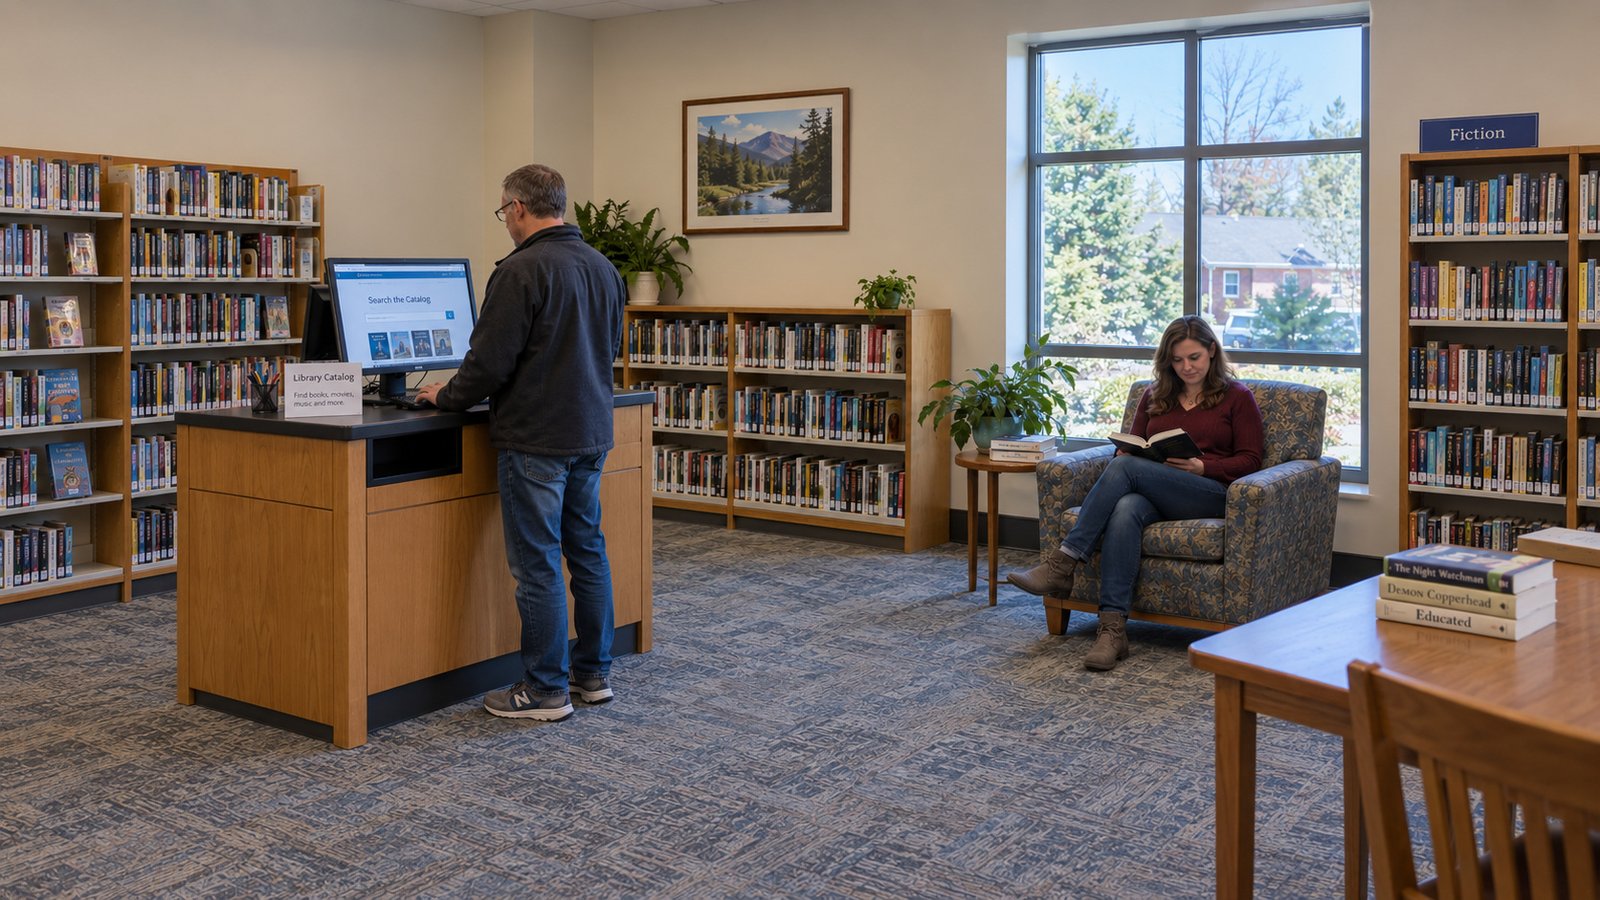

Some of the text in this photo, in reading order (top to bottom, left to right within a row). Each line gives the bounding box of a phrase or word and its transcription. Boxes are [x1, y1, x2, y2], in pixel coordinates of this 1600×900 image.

[1450, 127, 1505, 141] Fiction
[368, 296, 392, 304] Search
[405, 295, 431, 304] Catalog
[293, 373, 354, 383] Library Catalog
[1395, 563, 1411, 573] The
[1412, 566, 1436, 577] Night
[1438, 569, 1484, 584] Watchman
[1427, 589, 1492, 609] Copperhead
[1416, 609, 1472, 628] Educated
